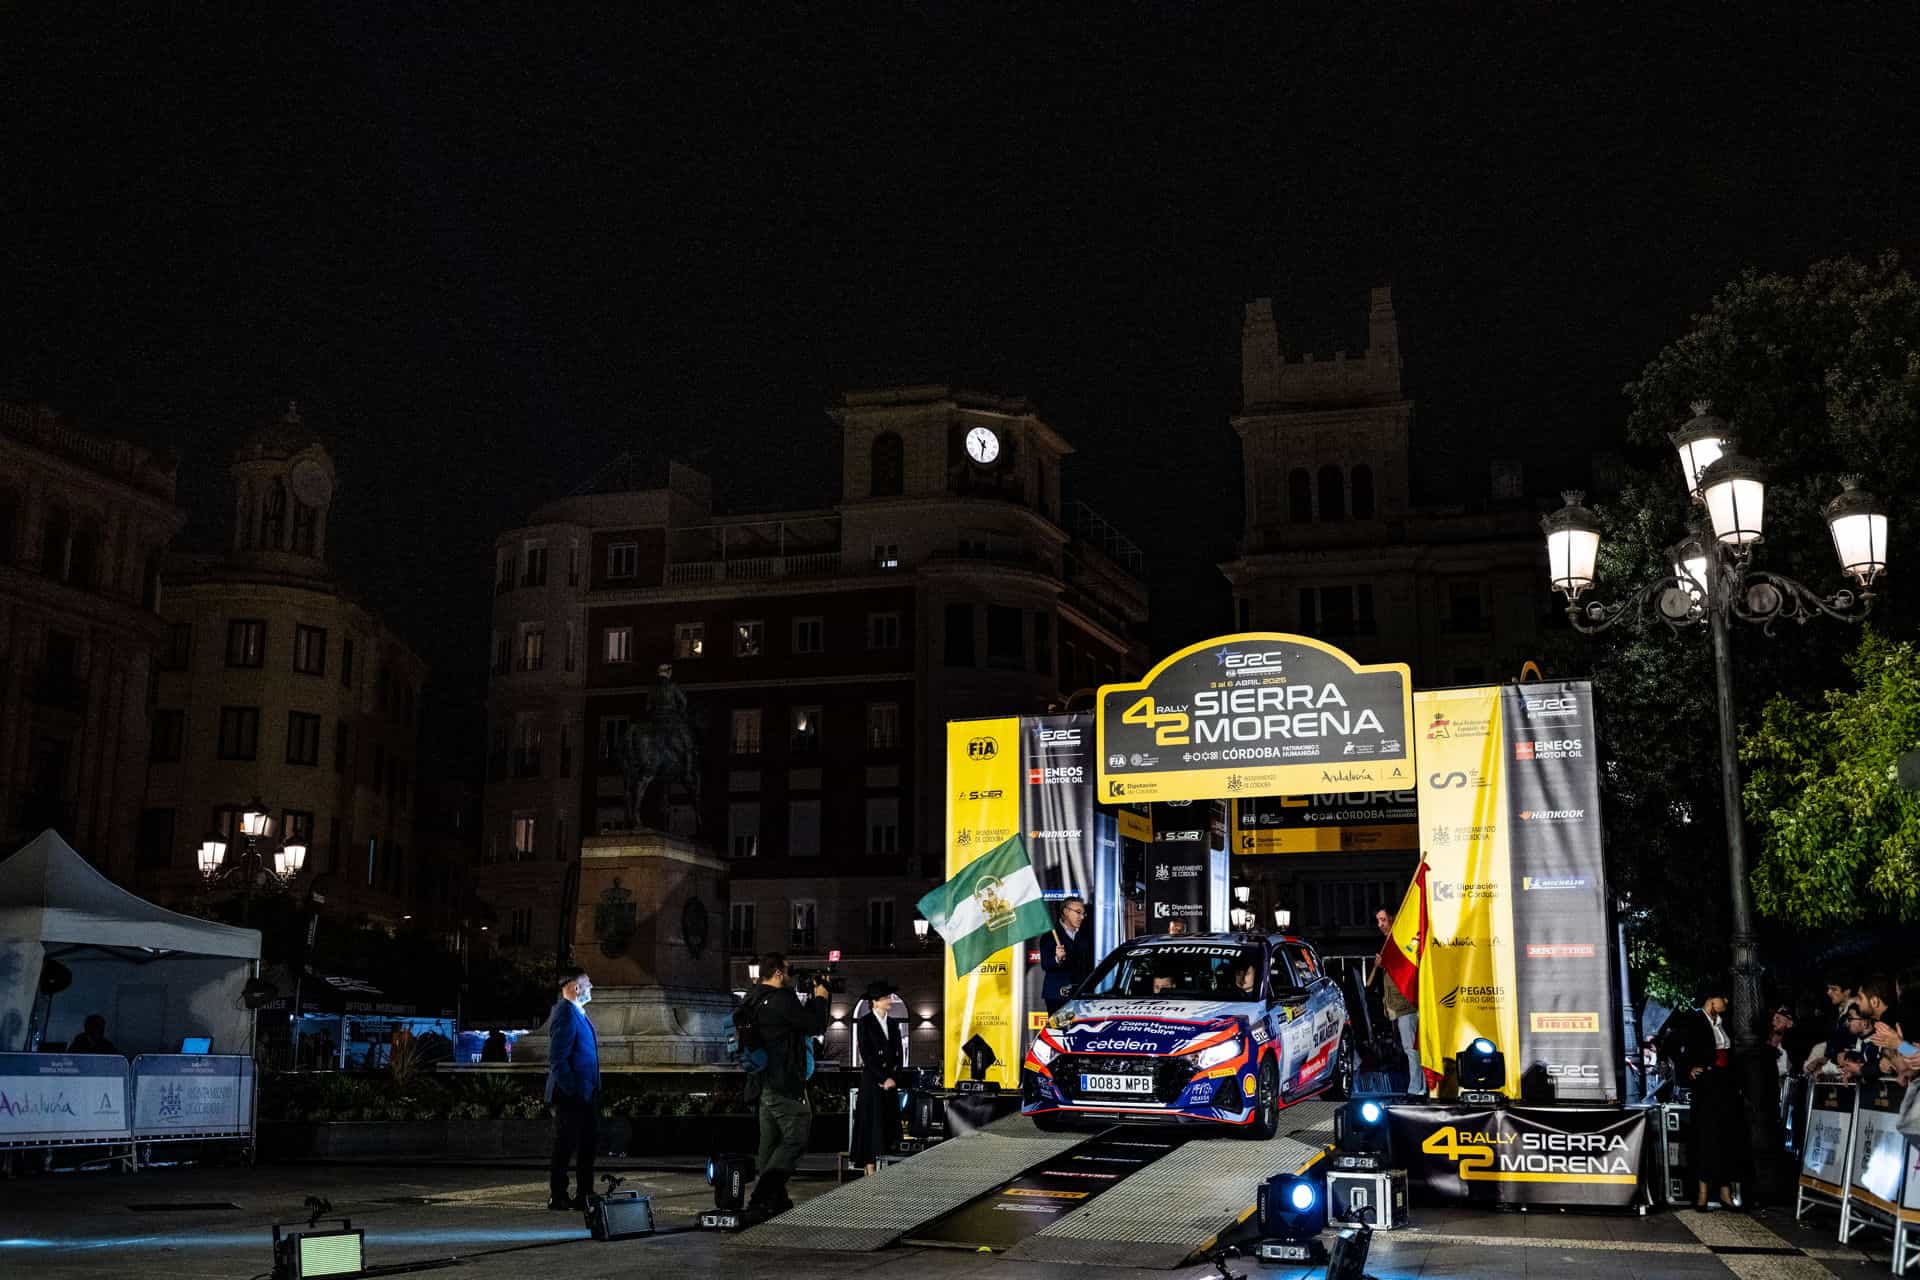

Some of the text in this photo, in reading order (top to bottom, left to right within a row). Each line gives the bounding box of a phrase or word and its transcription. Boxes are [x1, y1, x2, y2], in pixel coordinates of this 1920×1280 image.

[1225, 652, 1282, 668] ERC
[1235, 678, 1262, 687] ABRIL
[1194, 683, 1348, 716] SIERRA
[1527, 697, 1577, 711] ERC
[1156, 705, 1189, 713] RALLY
[1195, 709, 1385, 744] MORENA
[1040, 729, 1081, 741] ERC
[1534, 739, 1583, 751] ENEOS
[1222, 747, 1281, 760] CÓRDOBA
[1535, 750, 1583, 760] MOTOR OIL
[1044, 766, 1083, 777] ENEOS
[1072, 776, 1083, 784] OIL
[1336, 810, 1385, 820] CÓRDOBA
[1158, 945, 1242, 958] HYUNDAI
[1460, 986, 1505, 996] PEGASUS
[1100, 1005, 1187, 1013] HYUNDAI
[1537, 1015, 1593, 1029] PIRELLI
[1085, 1037, 1158, 1051] cetelem
[1547, 1064, 1599, 1077] ERC
[1089, 1076, 1150, 1091] 0083 MPB
[1460, 1131, 1630, 1151] RALLY SIERRA
[1500, 1154, 1632, 1174] MORENA
